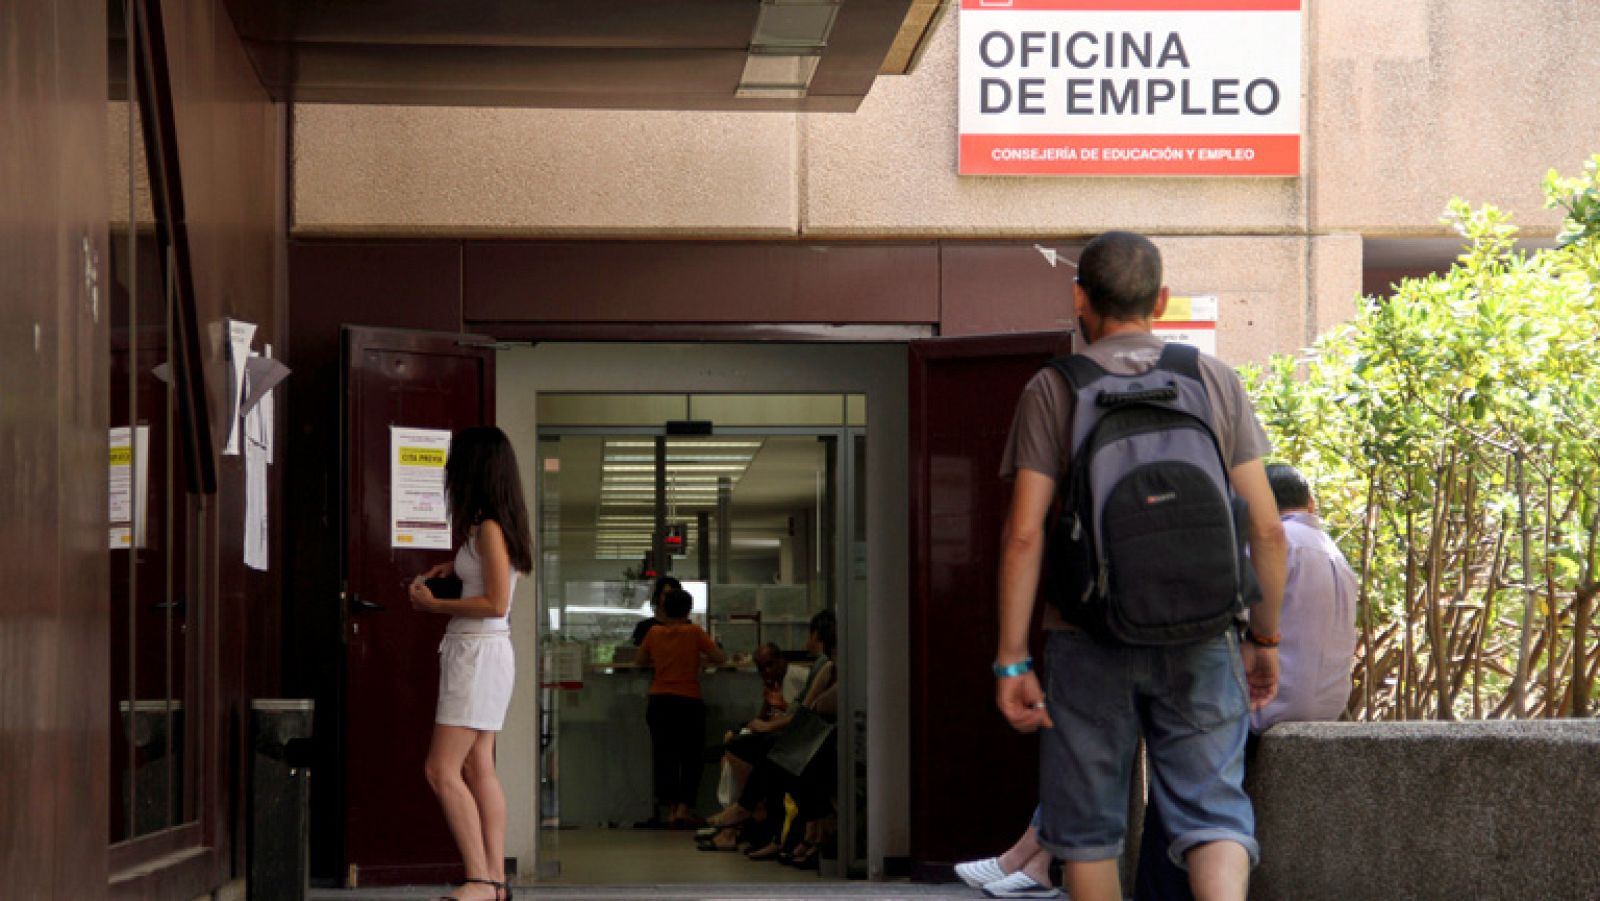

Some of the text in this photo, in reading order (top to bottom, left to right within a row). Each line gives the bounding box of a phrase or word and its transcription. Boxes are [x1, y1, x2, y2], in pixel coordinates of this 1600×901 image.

[979, 30, 1190, 69] OFICINA
[979, 77, 1280, 116] DE EMPLEO
[991, 146, 1255, 160] CONSEJERÍA DE EDUCACIÓN Y EMPLEO
